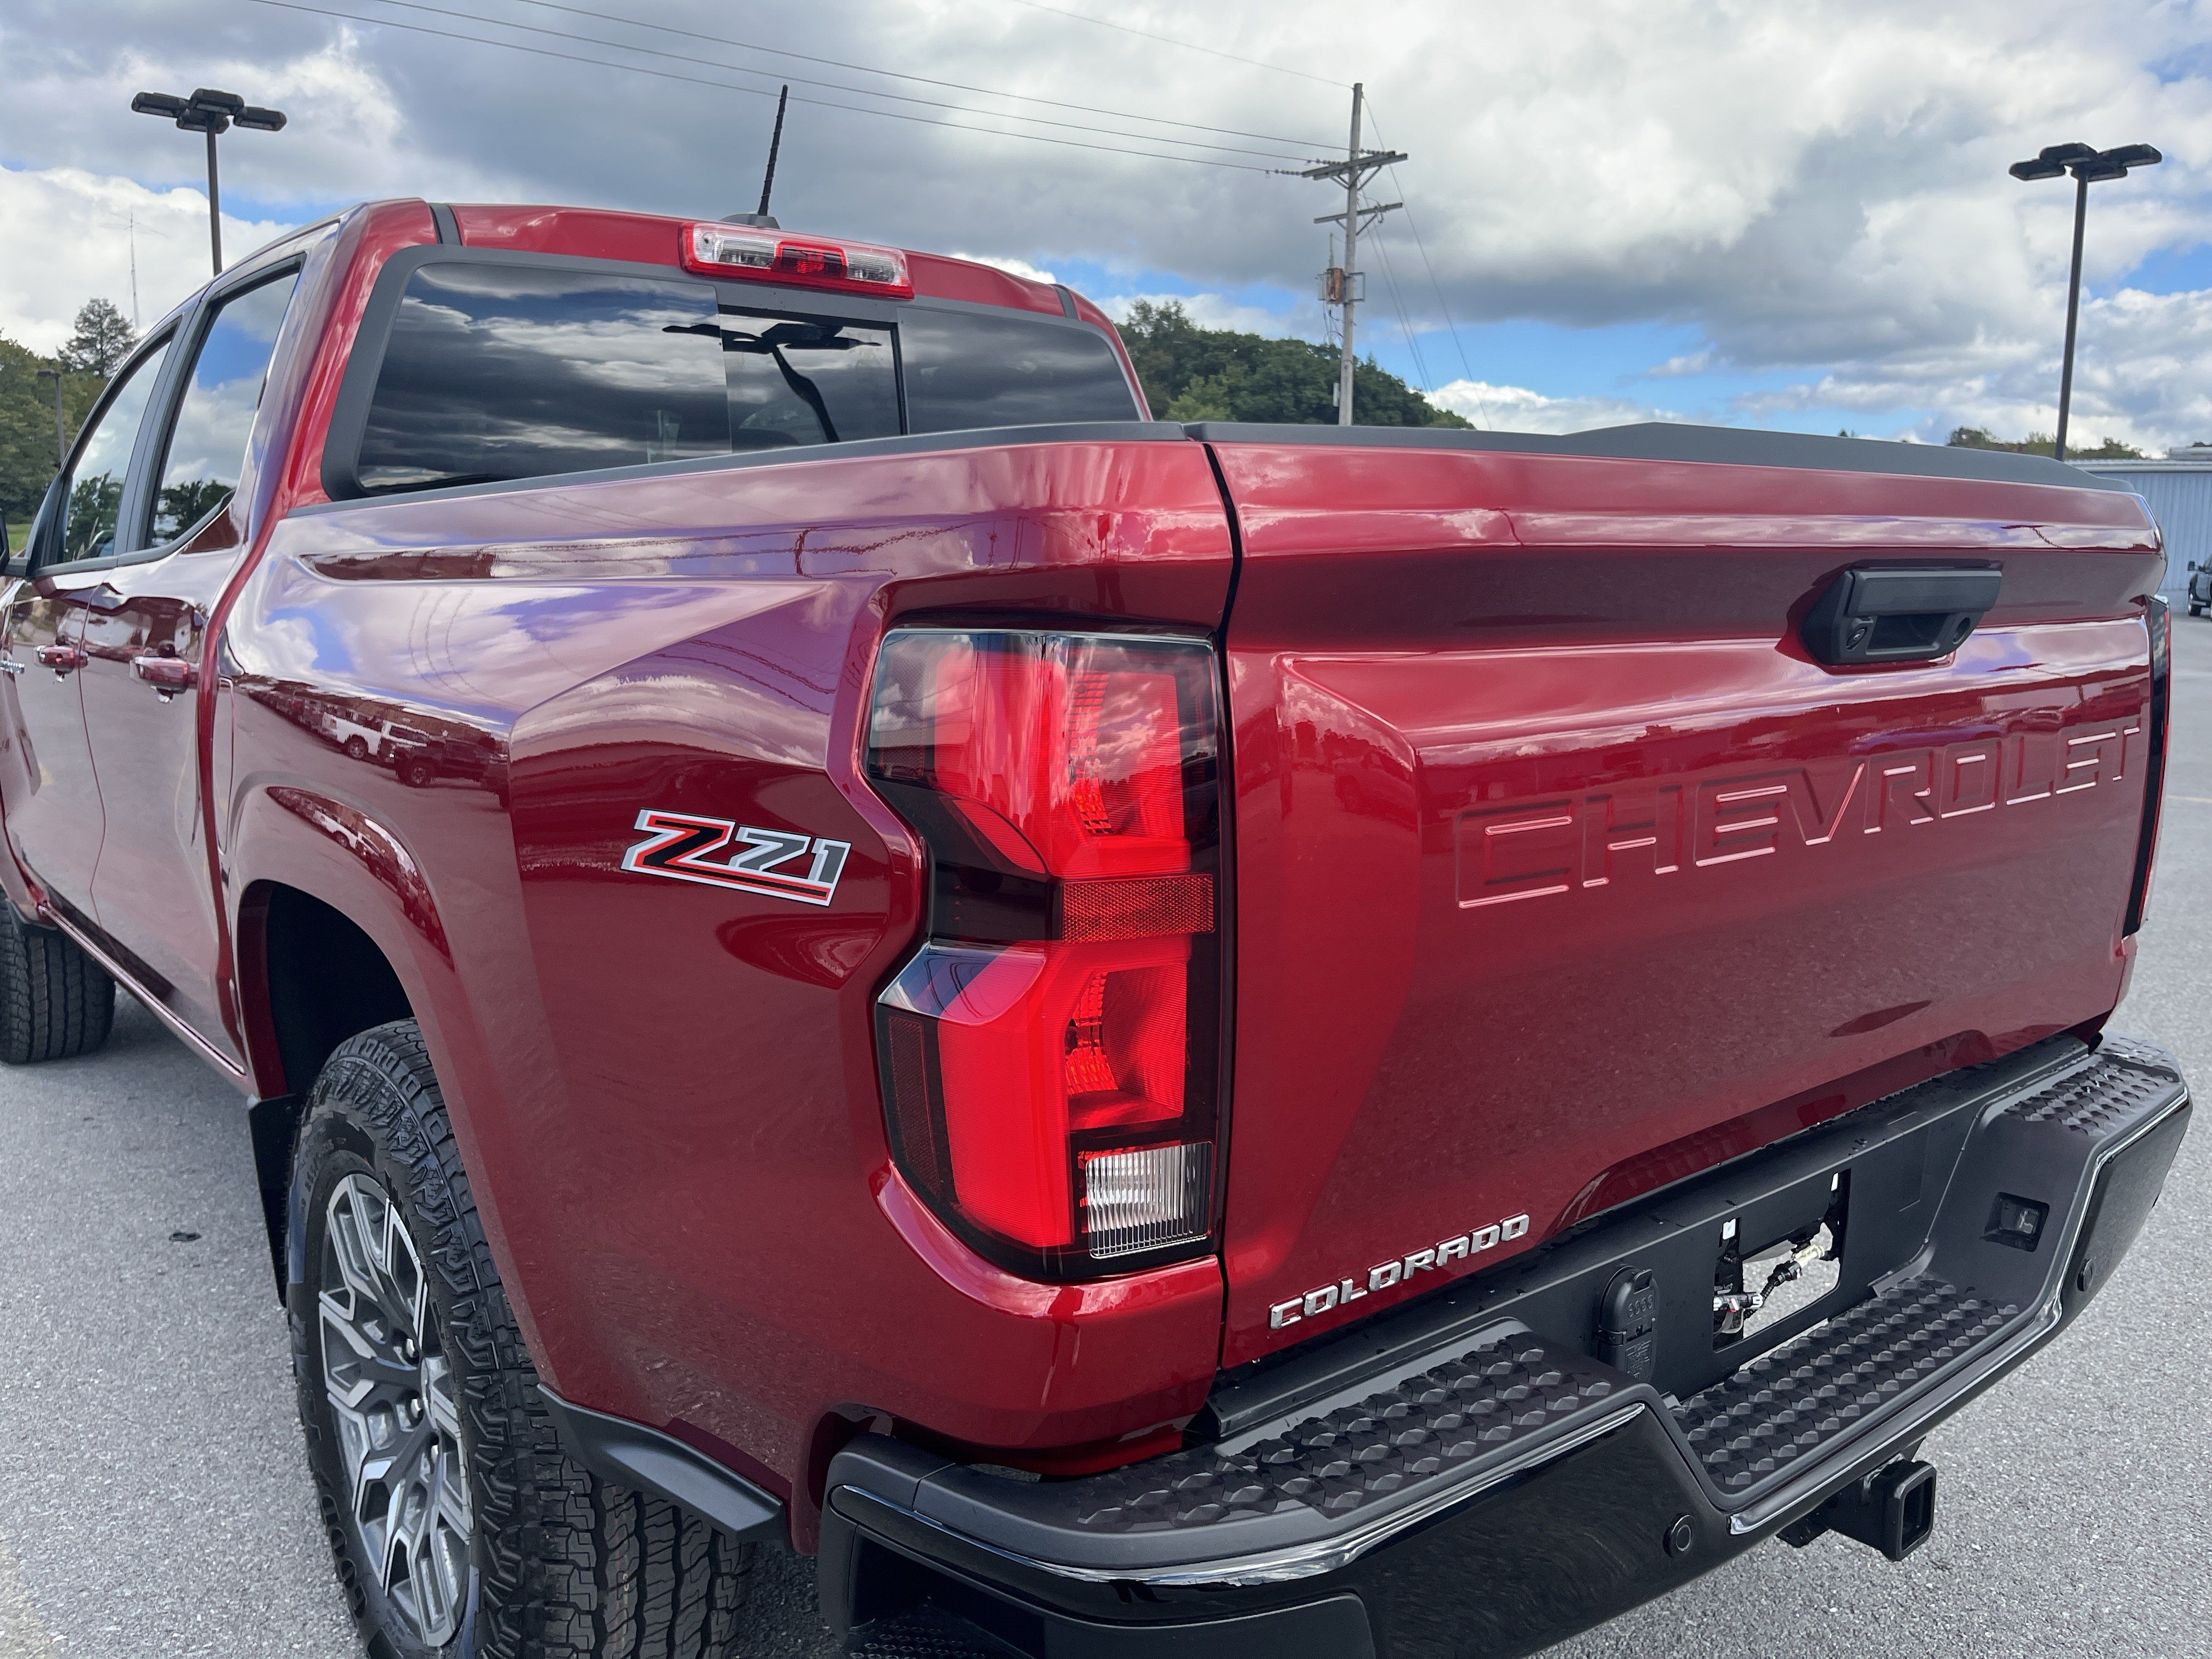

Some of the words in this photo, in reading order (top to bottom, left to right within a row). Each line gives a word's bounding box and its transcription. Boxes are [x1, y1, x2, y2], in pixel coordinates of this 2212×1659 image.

[620, 808, 852, 907] Z71
[1455, 718, 2141, 909] CHEVROLET
[1269, 1212, 1530, 1330] COLORADO
